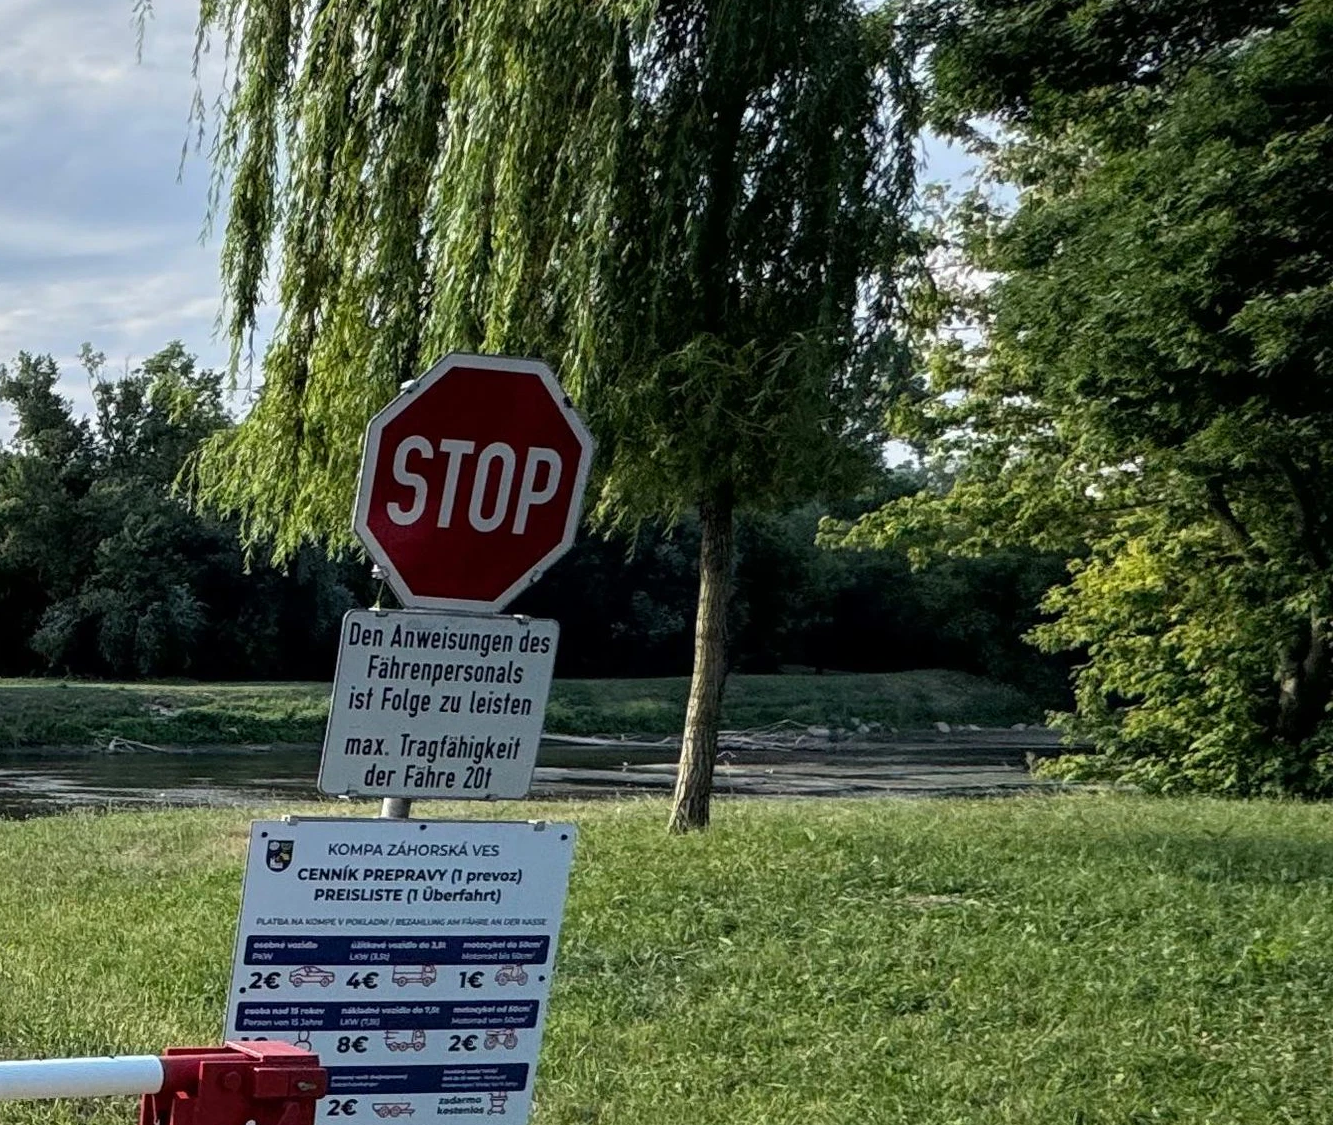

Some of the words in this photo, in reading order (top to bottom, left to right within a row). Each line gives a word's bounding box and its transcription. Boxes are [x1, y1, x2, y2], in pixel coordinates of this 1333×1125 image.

[386, 435, 563, 535] STOP
[349, 622, 383, 646] Den
[390, 624, 513, 657] Anweisungen
[518, 630, 551, 654] des
[367, 655, 524, 687] Fährenpersonals
[348, 686, 374, 710] ist
[381, 687, 431, 718] Folge
[439, 695, 461, 713] zu
[469, 691, 532, 716] leisten
[344, 738, 390, 756] max.
[400, 734, 521, 764] Tragfähigkeit
[364, 764, 396, 786] der
[403, 765, 455, 788] Fähre
[462, 766, 493, 789] 20t
[328, 844, 382, 856] KOMPA
[387, 841, 468, 857] ZÁHORSKÁ
[472, 845, 499, 856] VES
[297, 866, 359, 881] CENNÍK
[362, 869, 448, 881] PREPRAVY
[451, 868, 463, 883] (1
[466, 868, 523, 883] prevoz)
[314, 889, 403, 901] PREISLISTE
[406, 888, 418, 904] (1
[422, 886, 501, 903] Überfahrt)
[249, 972, 281, 989] 2€
[346, 972, 379, 989] 4€
[459, 971, 485, 989] 1€
[337, 1036, 369, 1053] 8€
[448, 1035, 479, 1052] 2€
[327, 1099, 358, 1116] 2€
[438, 1096, 482, 1105] zadarmo
[437, 1106, 485, 1116] kostenlos
